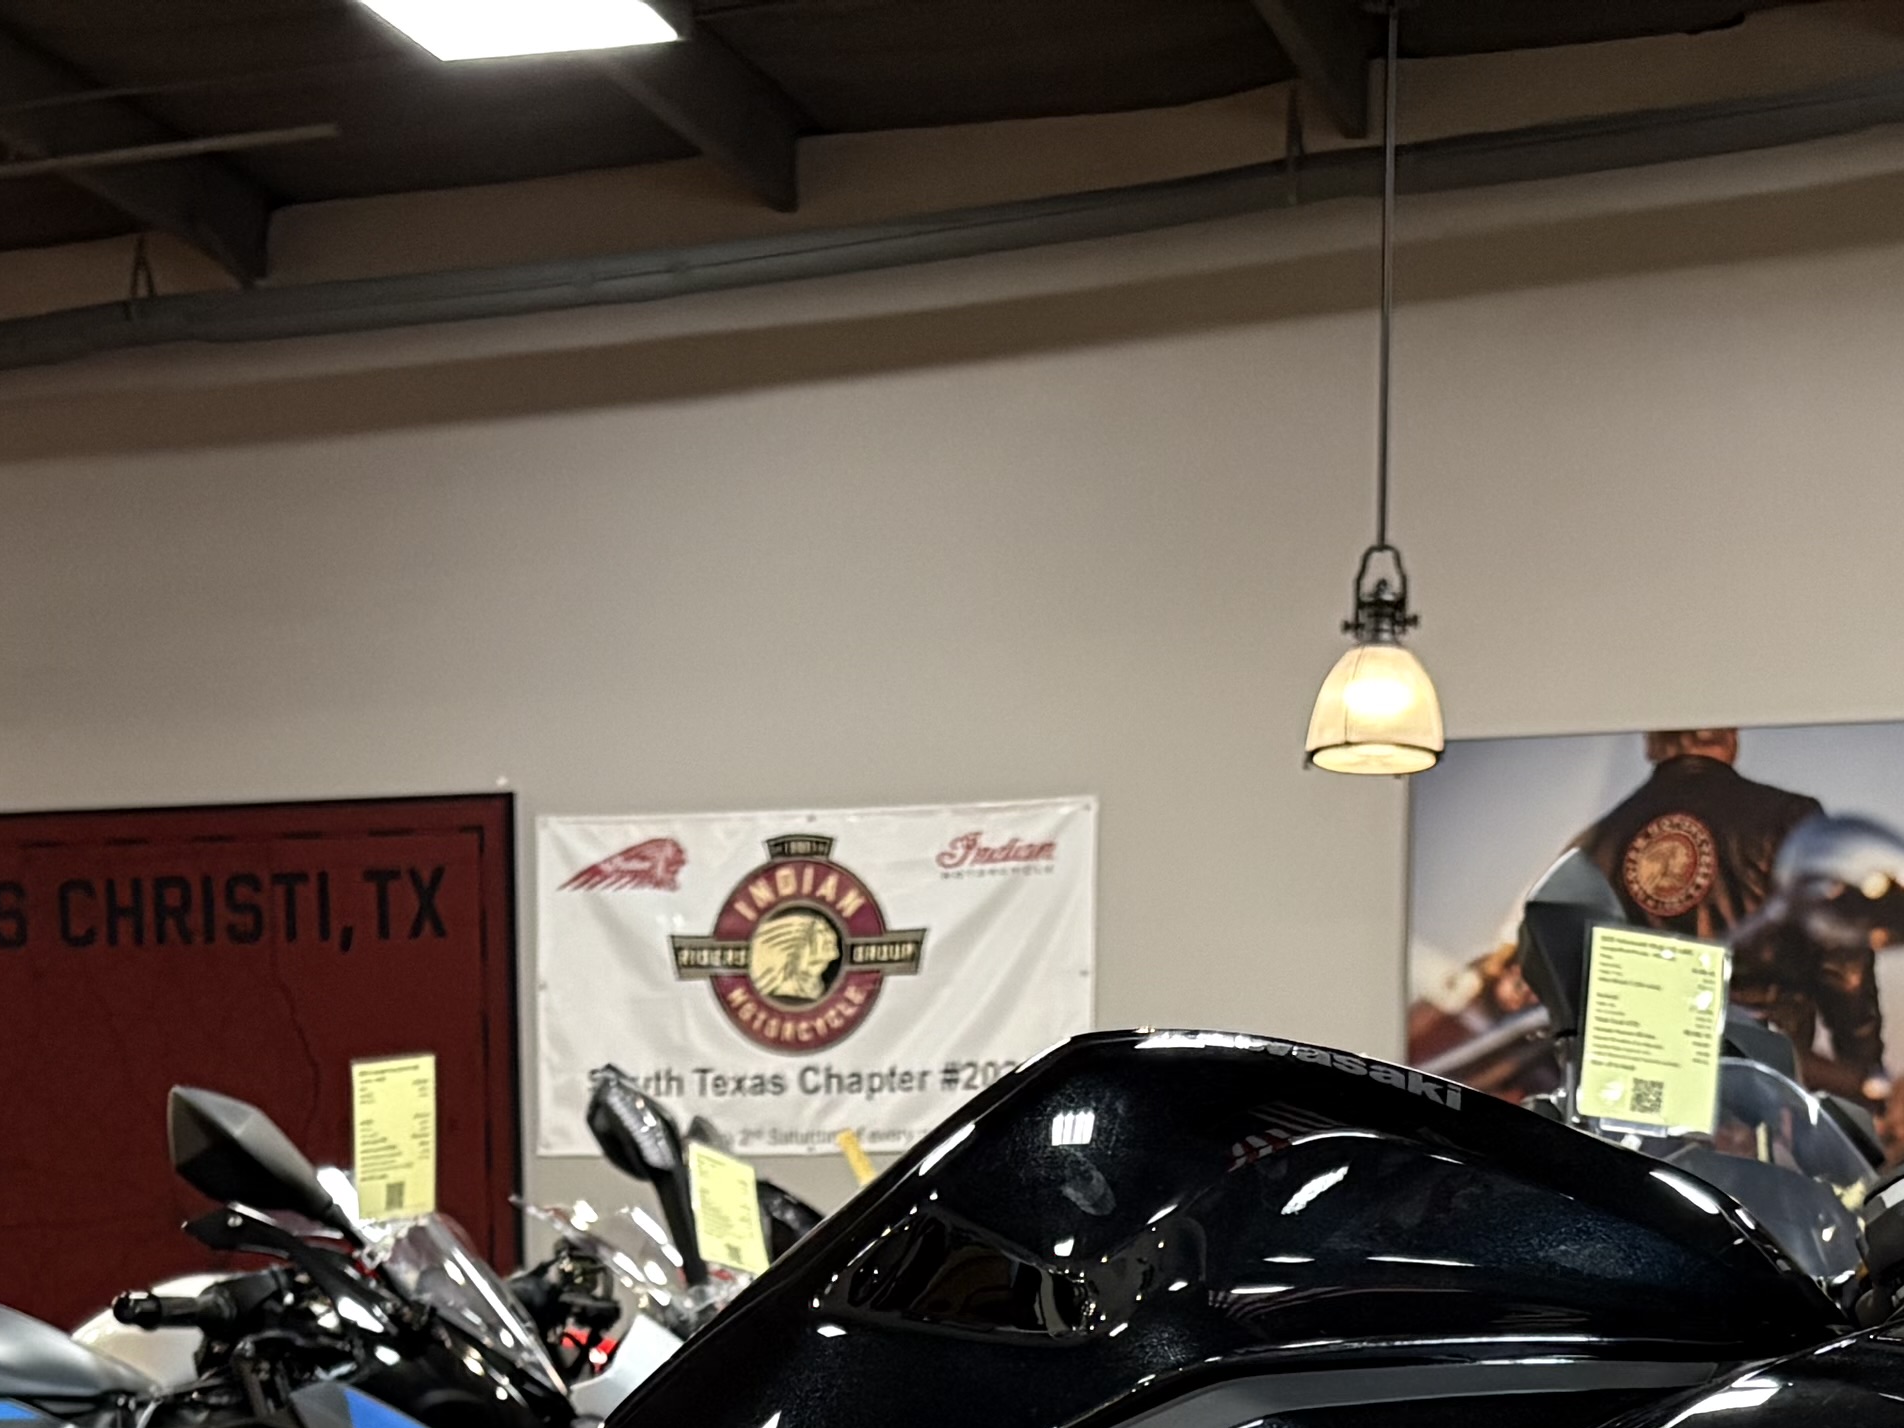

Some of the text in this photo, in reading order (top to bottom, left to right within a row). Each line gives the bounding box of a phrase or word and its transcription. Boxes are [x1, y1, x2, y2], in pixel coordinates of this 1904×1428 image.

[936, 831, 1058, 869] Indian
[735, 866, 867, 921] INDIAN
[727, 984, 869, 1042] MOTORCYCLE
[694, 1065, 787, 1099] Texas
[808, 1061, 930, 1106] Chapter
